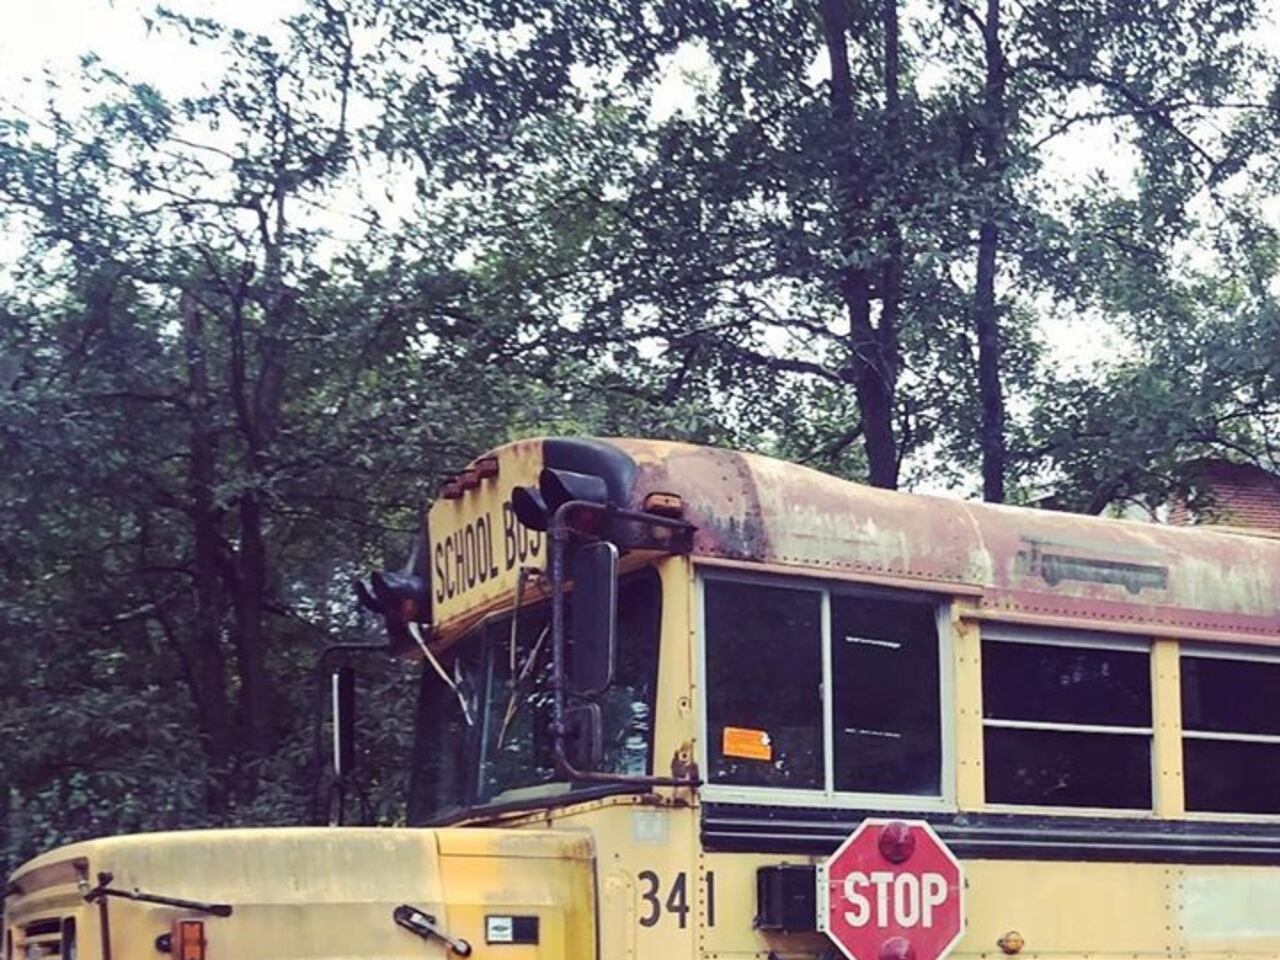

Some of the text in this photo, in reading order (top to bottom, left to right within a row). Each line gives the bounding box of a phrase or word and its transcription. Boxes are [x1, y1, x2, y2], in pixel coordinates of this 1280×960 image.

[435, 511, 499, 605] SCHOOL
[637, 870, 716, 929] 341
[843, 871, 948, 928] STOP
